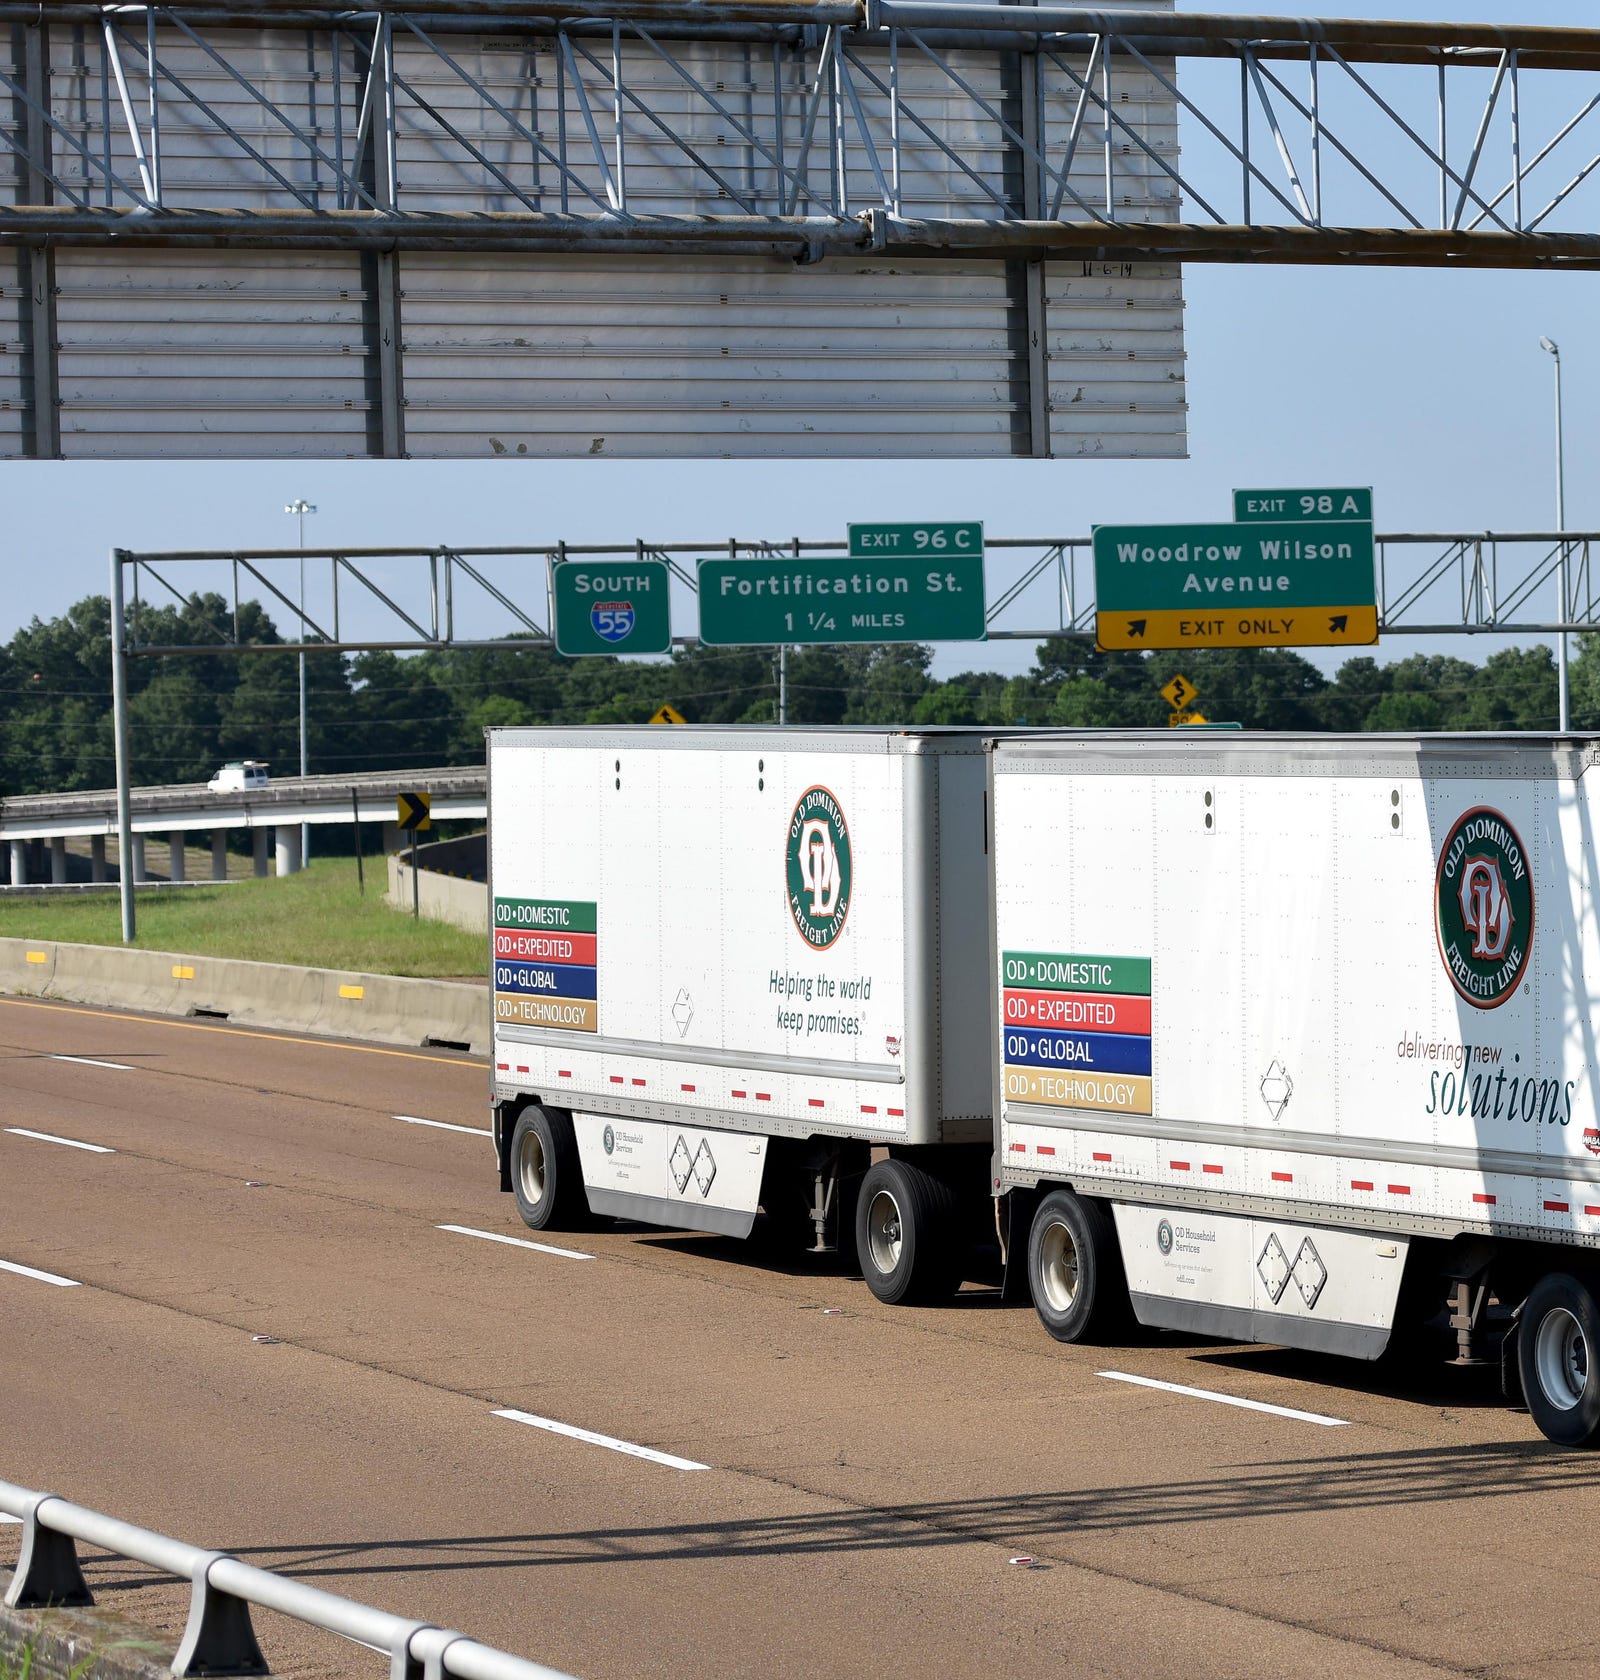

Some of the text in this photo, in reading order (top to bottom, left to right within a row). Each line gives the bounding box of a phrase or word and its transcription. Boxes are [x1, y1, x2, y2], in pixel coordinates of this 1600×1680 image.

[1247, 496, 1359, 514] EXIT 98 A
[861, 530, 970, 549] EXIT 96 C
[1117, 540, 1352, 563] Woodrow Wilson
[574, 574, 650, 593] SOUTH
[720, 572, 963, 596] Fortification St.
[1182, 573, 1291, 592] Avenue
[599, 612, 630, 634] 55
[785, 613, 793, 631] 1
[852, 614, 905, 628] MILES
[1180, 619, 1294, 636] EXIT ONLY
[791, 792, 846, 840] OLD DOMINION
[1444, 819, 1525, 881] OLD DOMINION
[791, 895, 847, 944] FREIGHT LINE
[1447, 941, 1522, 996] FREIGHT LINE
[769, 970, 871, 1001] Helping the world
[777, 1005, 803, 1036] keep
[1397, 1031, 1502, 1069] delivering new
[1426, 1045, 1575, 1126] solutions
[1175, 1226, 1216, 1242] OD Household
[1175, 1240, 1200, 1254] Services
